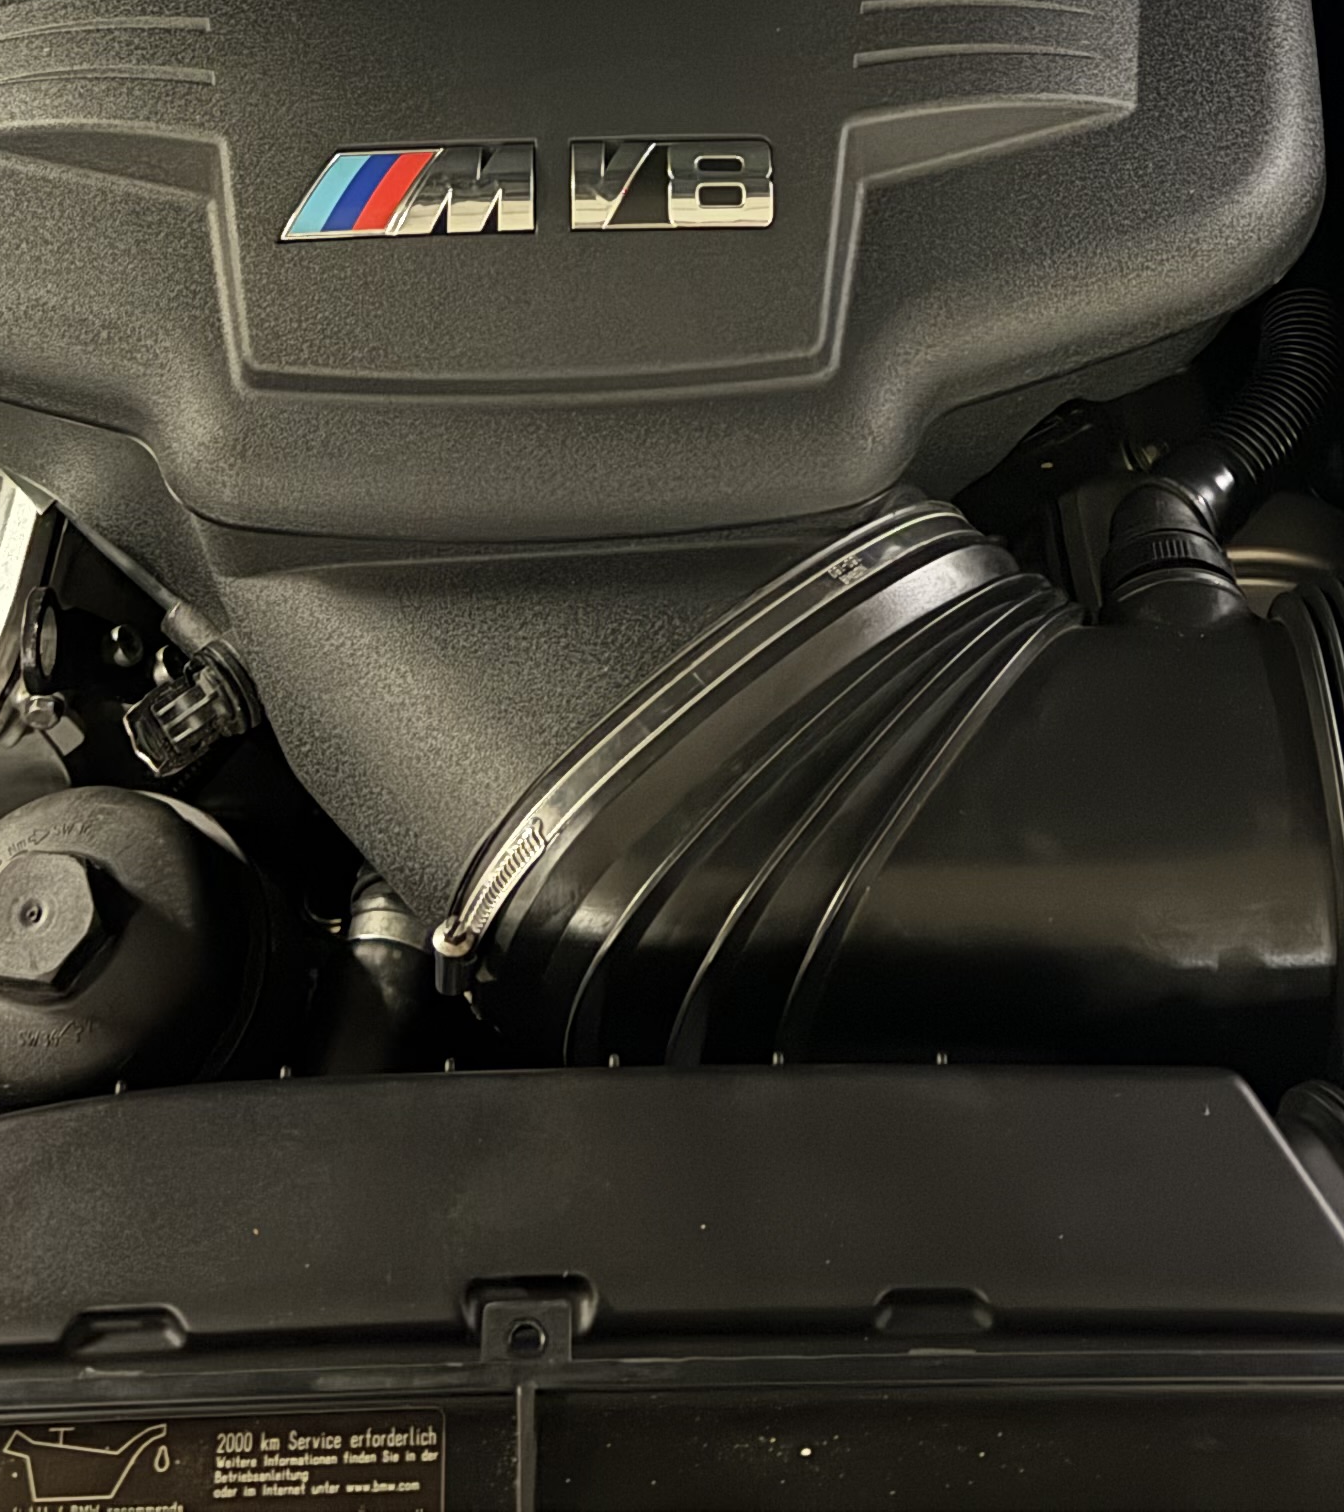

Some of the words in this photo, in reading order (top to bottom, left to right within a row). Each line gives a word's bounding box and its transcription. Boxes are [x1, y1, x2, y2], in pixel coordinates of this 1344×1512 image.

[216, 1432, 253, 1454] 2000
[260, 1430, 281, 1452] km
[288, 1429, 342, 1451] Service
[349, 1425, 438, 1449] erforderlich
[215, 1456, 258, 1469] Weitere
[263, 1454, 338, 1467] Informationen
[343, 1451, 377, 1464] finden
[261, 1483, 306, 1497] Internet
